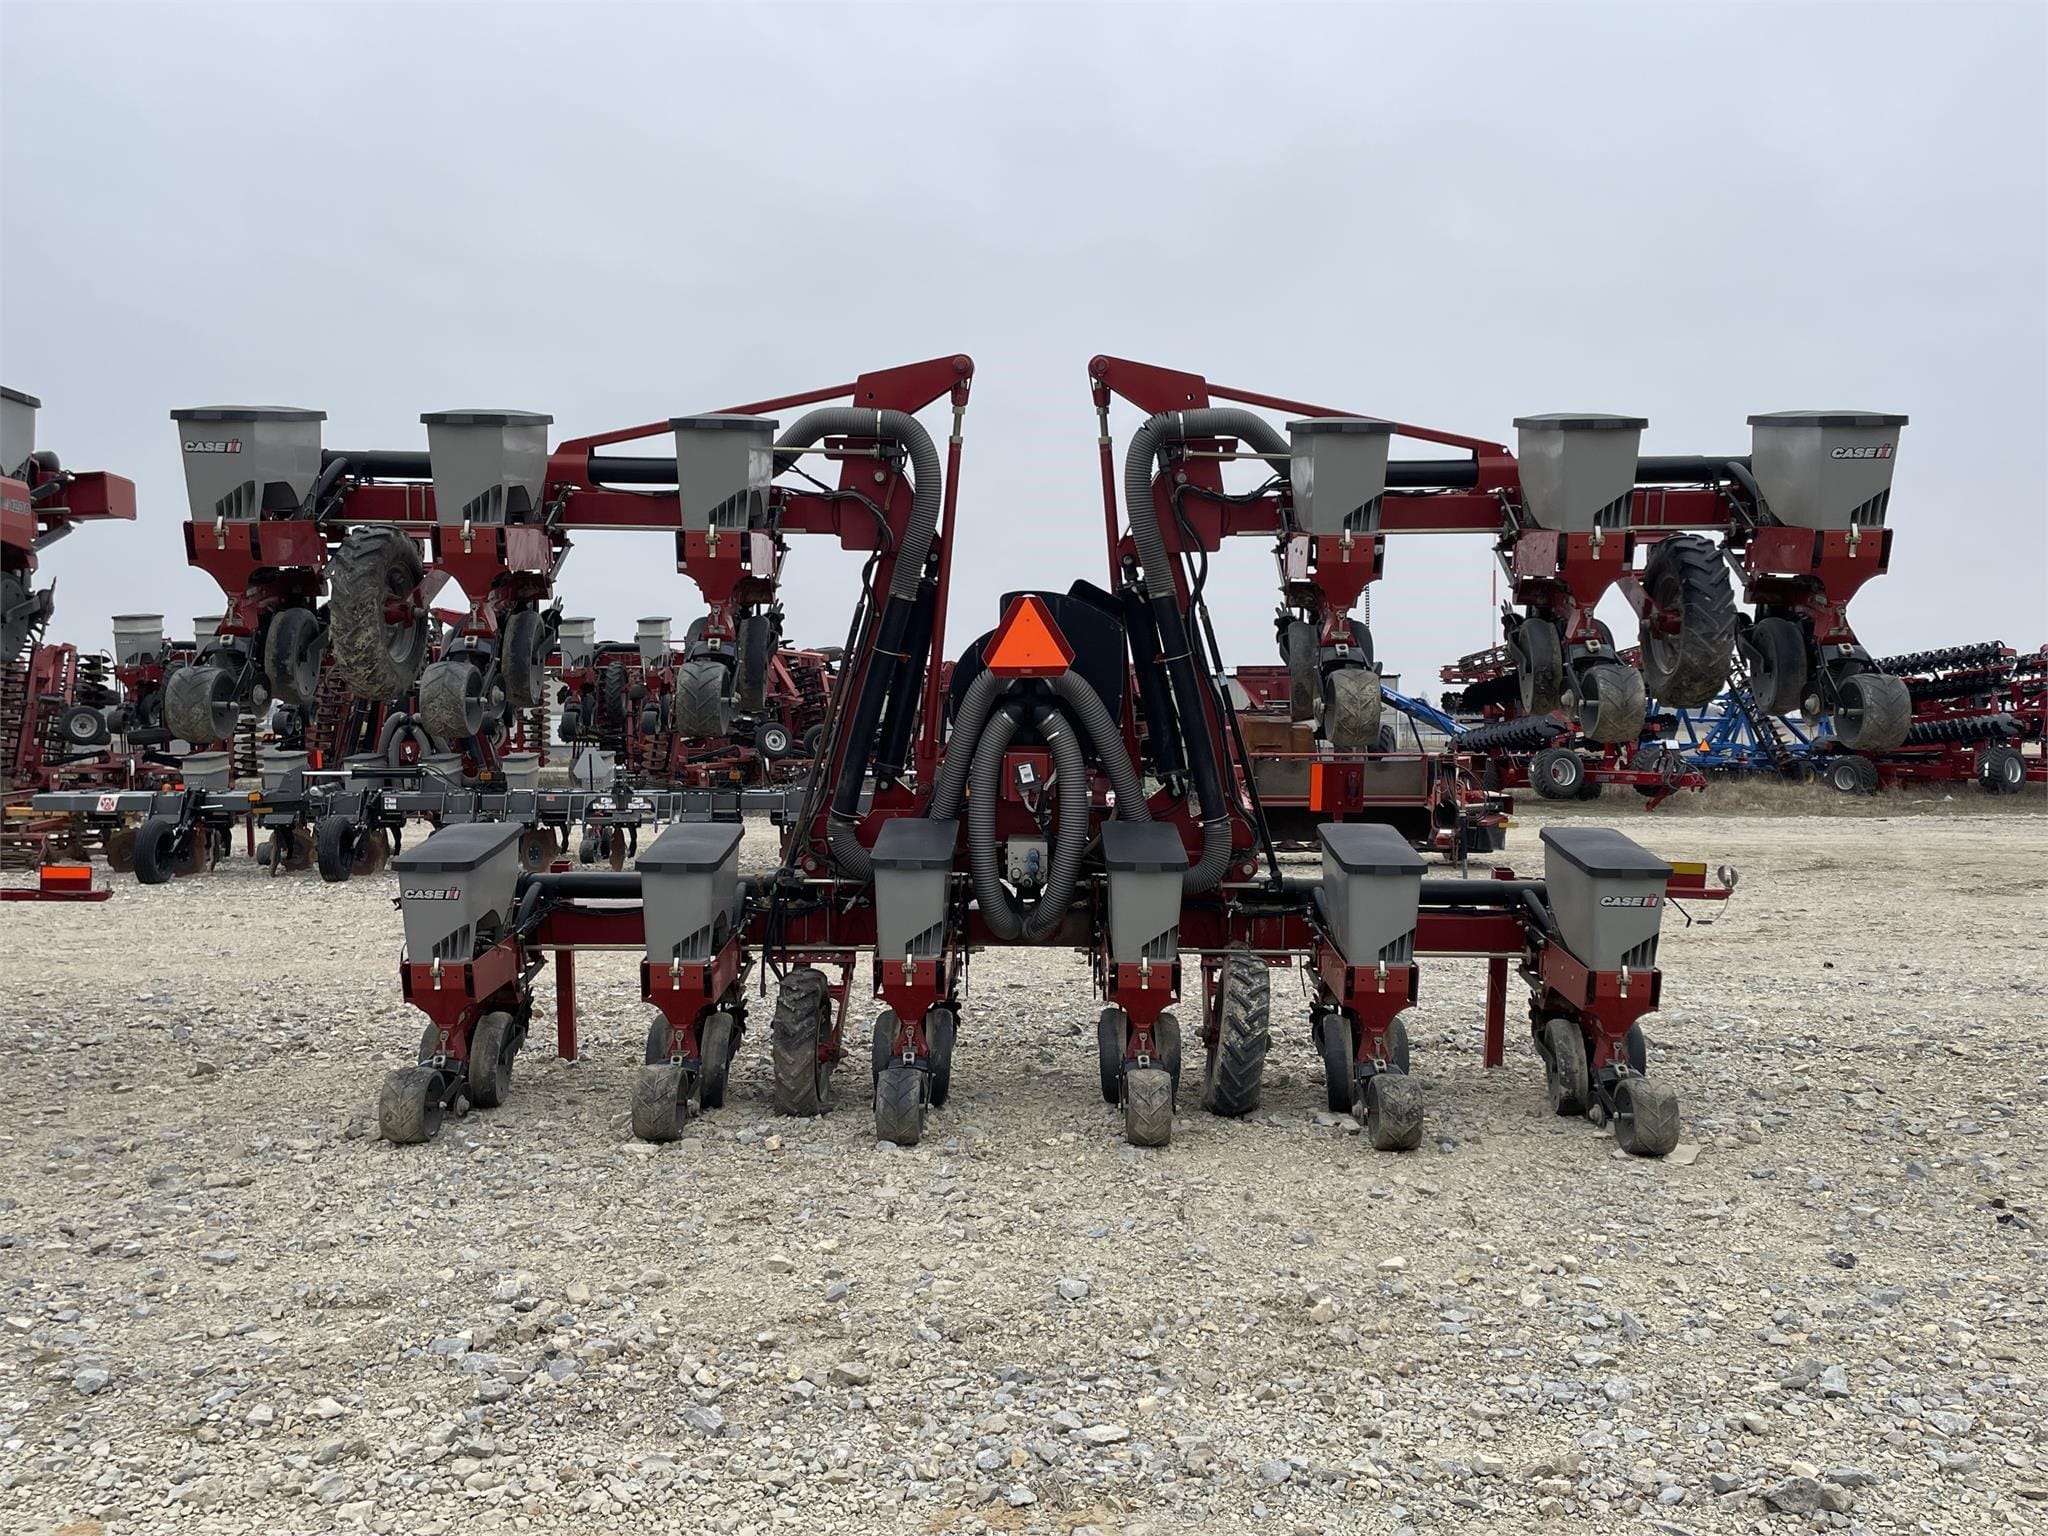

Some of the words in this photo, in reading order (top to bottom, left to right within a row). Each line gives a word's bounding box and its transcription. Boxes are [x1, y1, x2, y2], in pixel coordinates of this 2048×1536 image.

[184, 441, 226, 453] CASE
[1831, 447, 1877, 459] CASE
[404, 889, 445, 900] CASE
[1600, 896, 1643, 907] CASE
